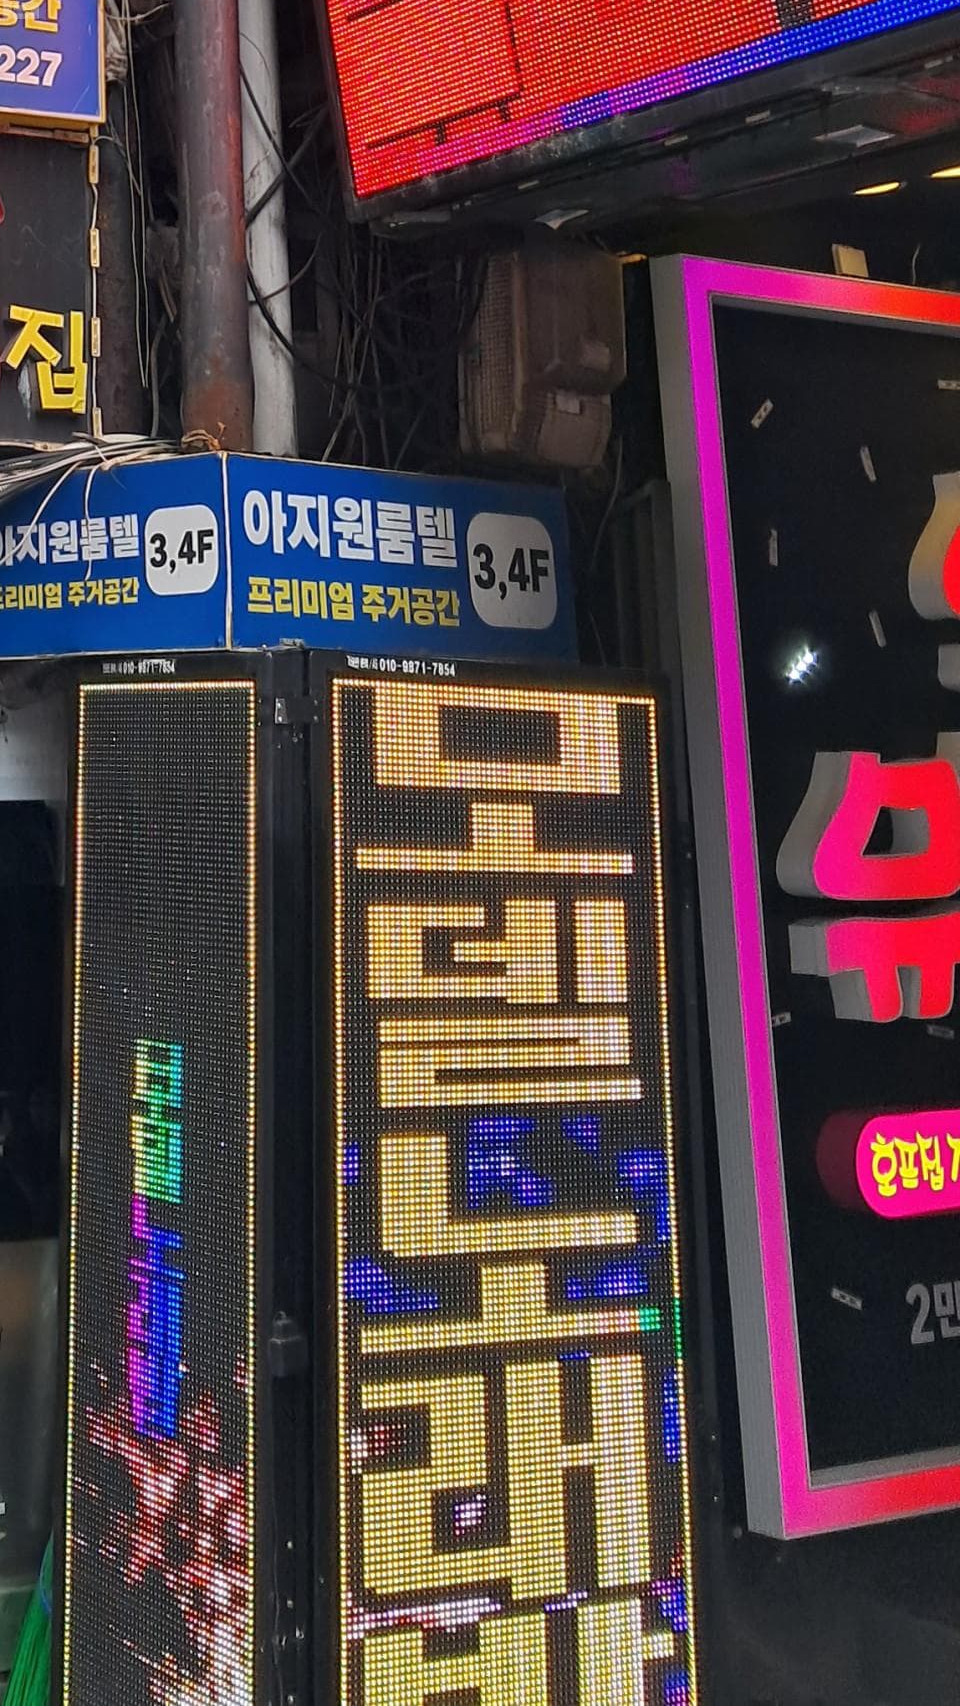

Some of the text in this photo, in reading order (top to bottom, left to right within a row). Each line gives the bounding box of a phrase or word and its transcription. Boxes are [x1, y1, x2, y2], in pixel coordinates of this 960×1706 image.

[4, 303, 88, 414] 집
[149, 529, 215, 574] 3,4F
[243, 489, 459, 570] 아지원룸텔
[68, 577, 139, 607] 주거공간
[473, 542, 551, 601] 3,4F
[247, 576, 461, 628] 프리미엄 주거공간
